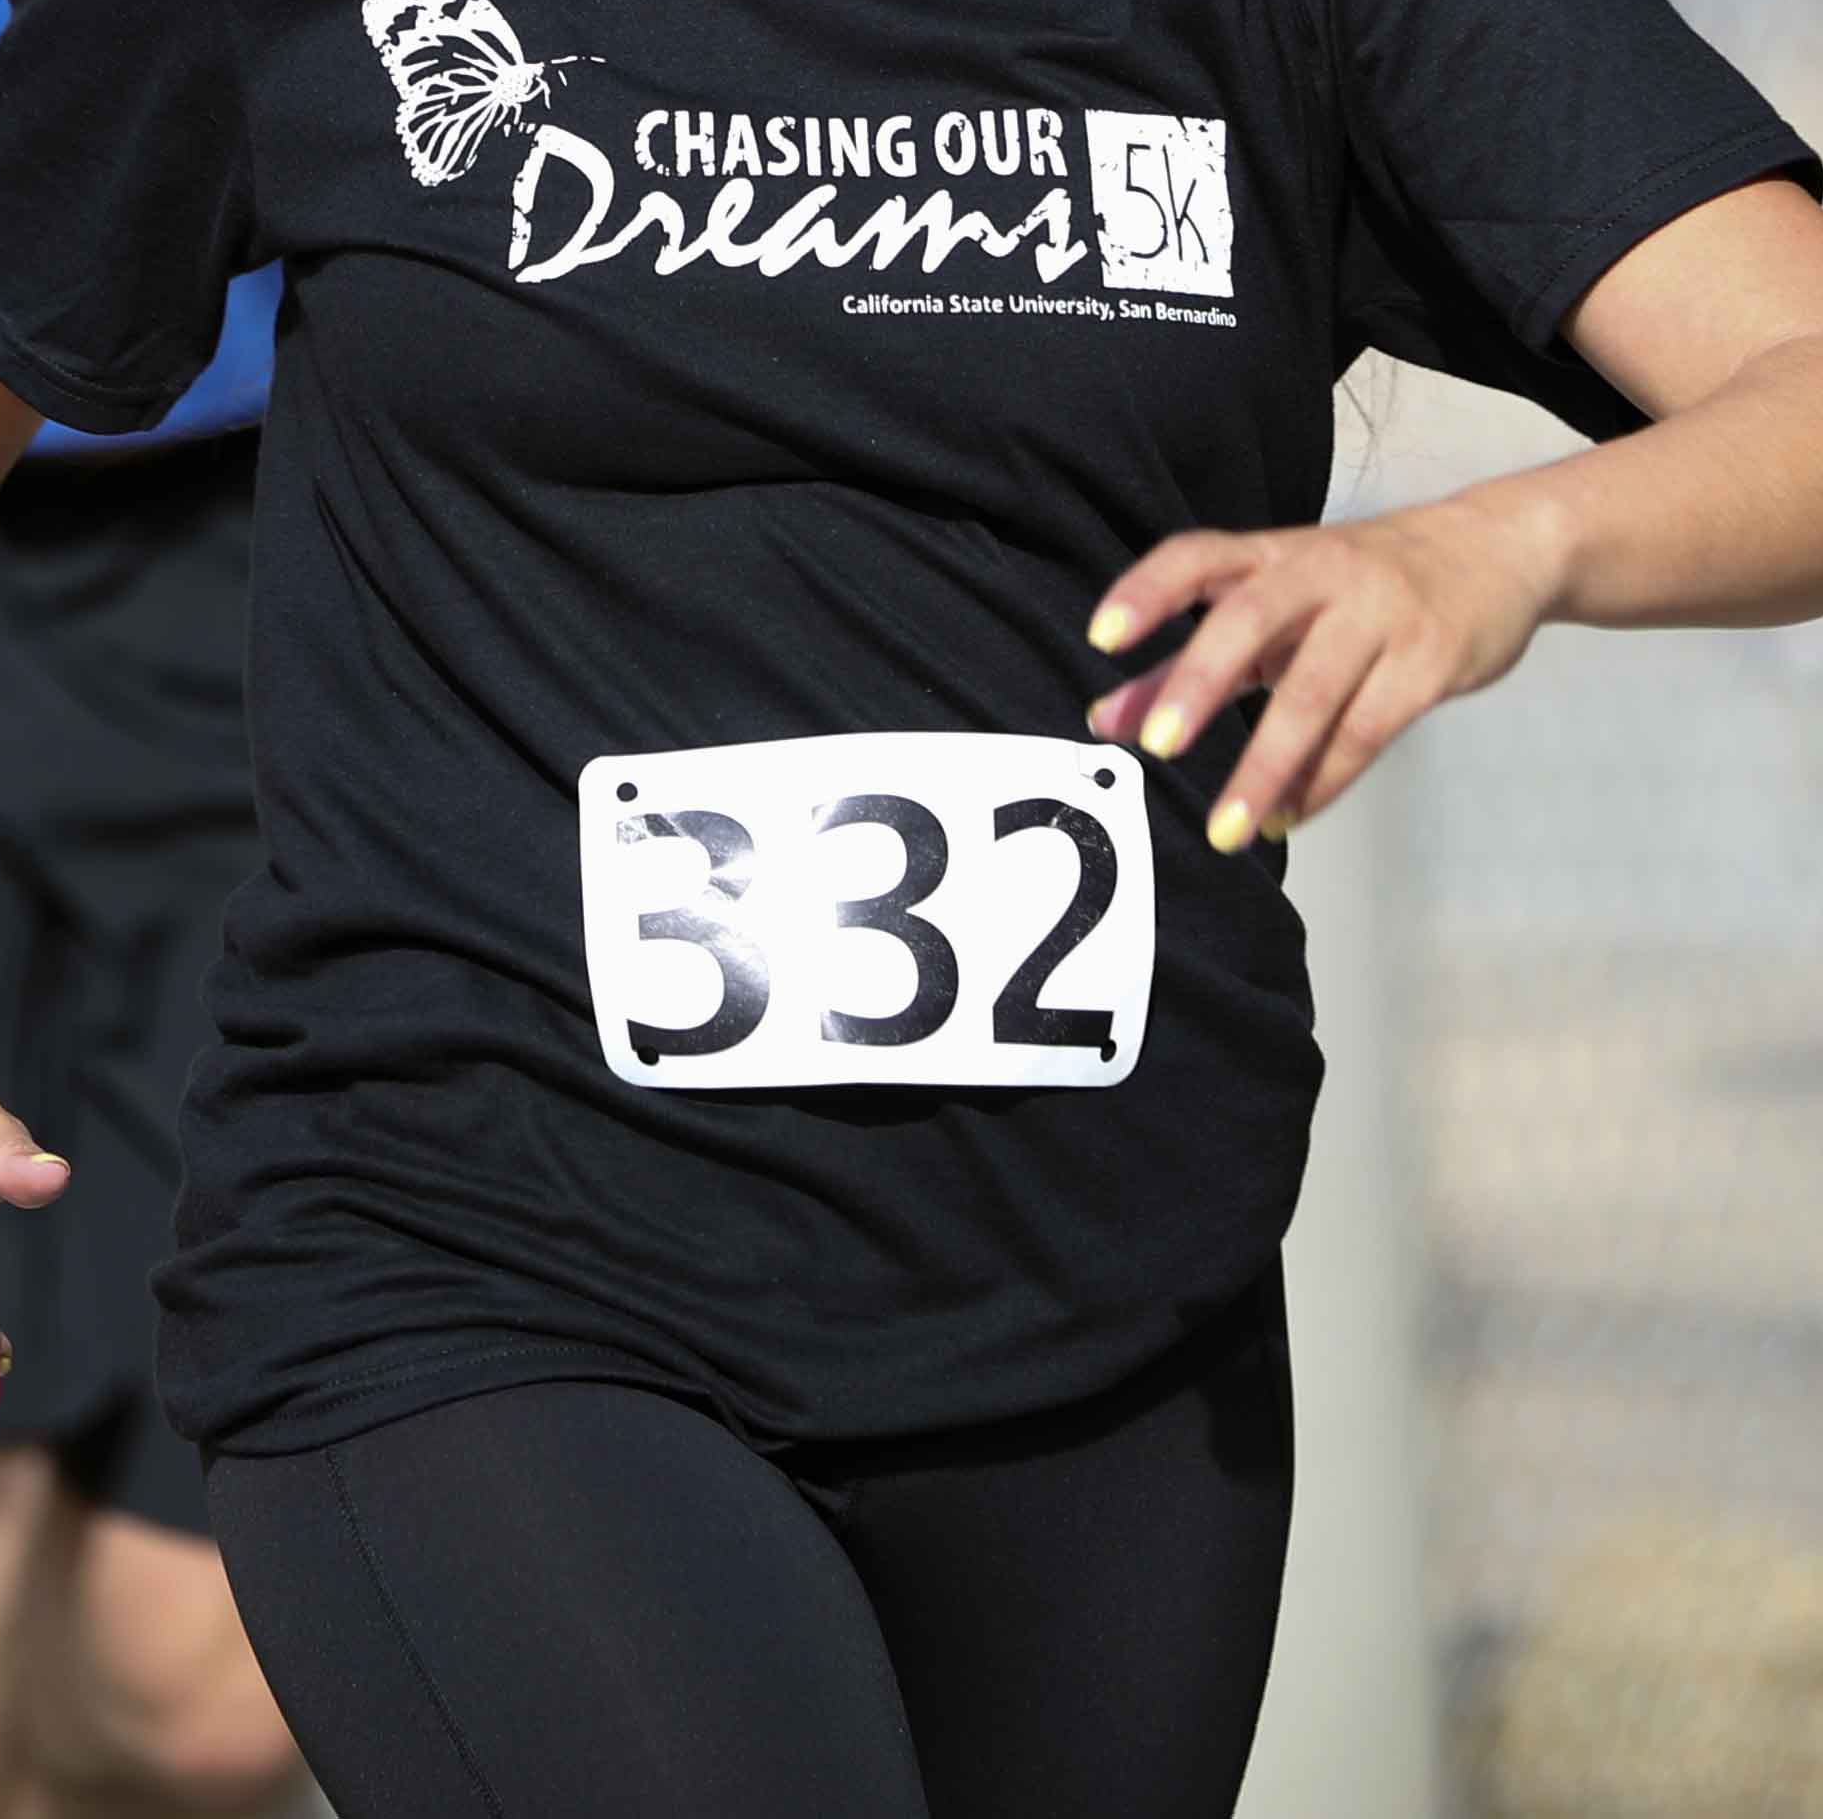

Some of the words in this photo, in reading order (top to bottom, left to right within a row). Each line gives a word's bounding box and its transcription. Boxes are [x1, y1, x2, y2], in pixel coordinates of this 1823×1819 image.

[634, 109, 917, 177] CHASING
[933, 109, 1068, 178] OUR
[508, 125, 1087, 284] Dreams
[842, 294, 944, 315] California
[949, 295, 1004, 314] State
[1009, 295, 1115, 321] University,
[1119, 299, 1152, 320] San
[1155, 305, 1238, 329] Bernardino
[616, 794, 1119, 1056] 332
